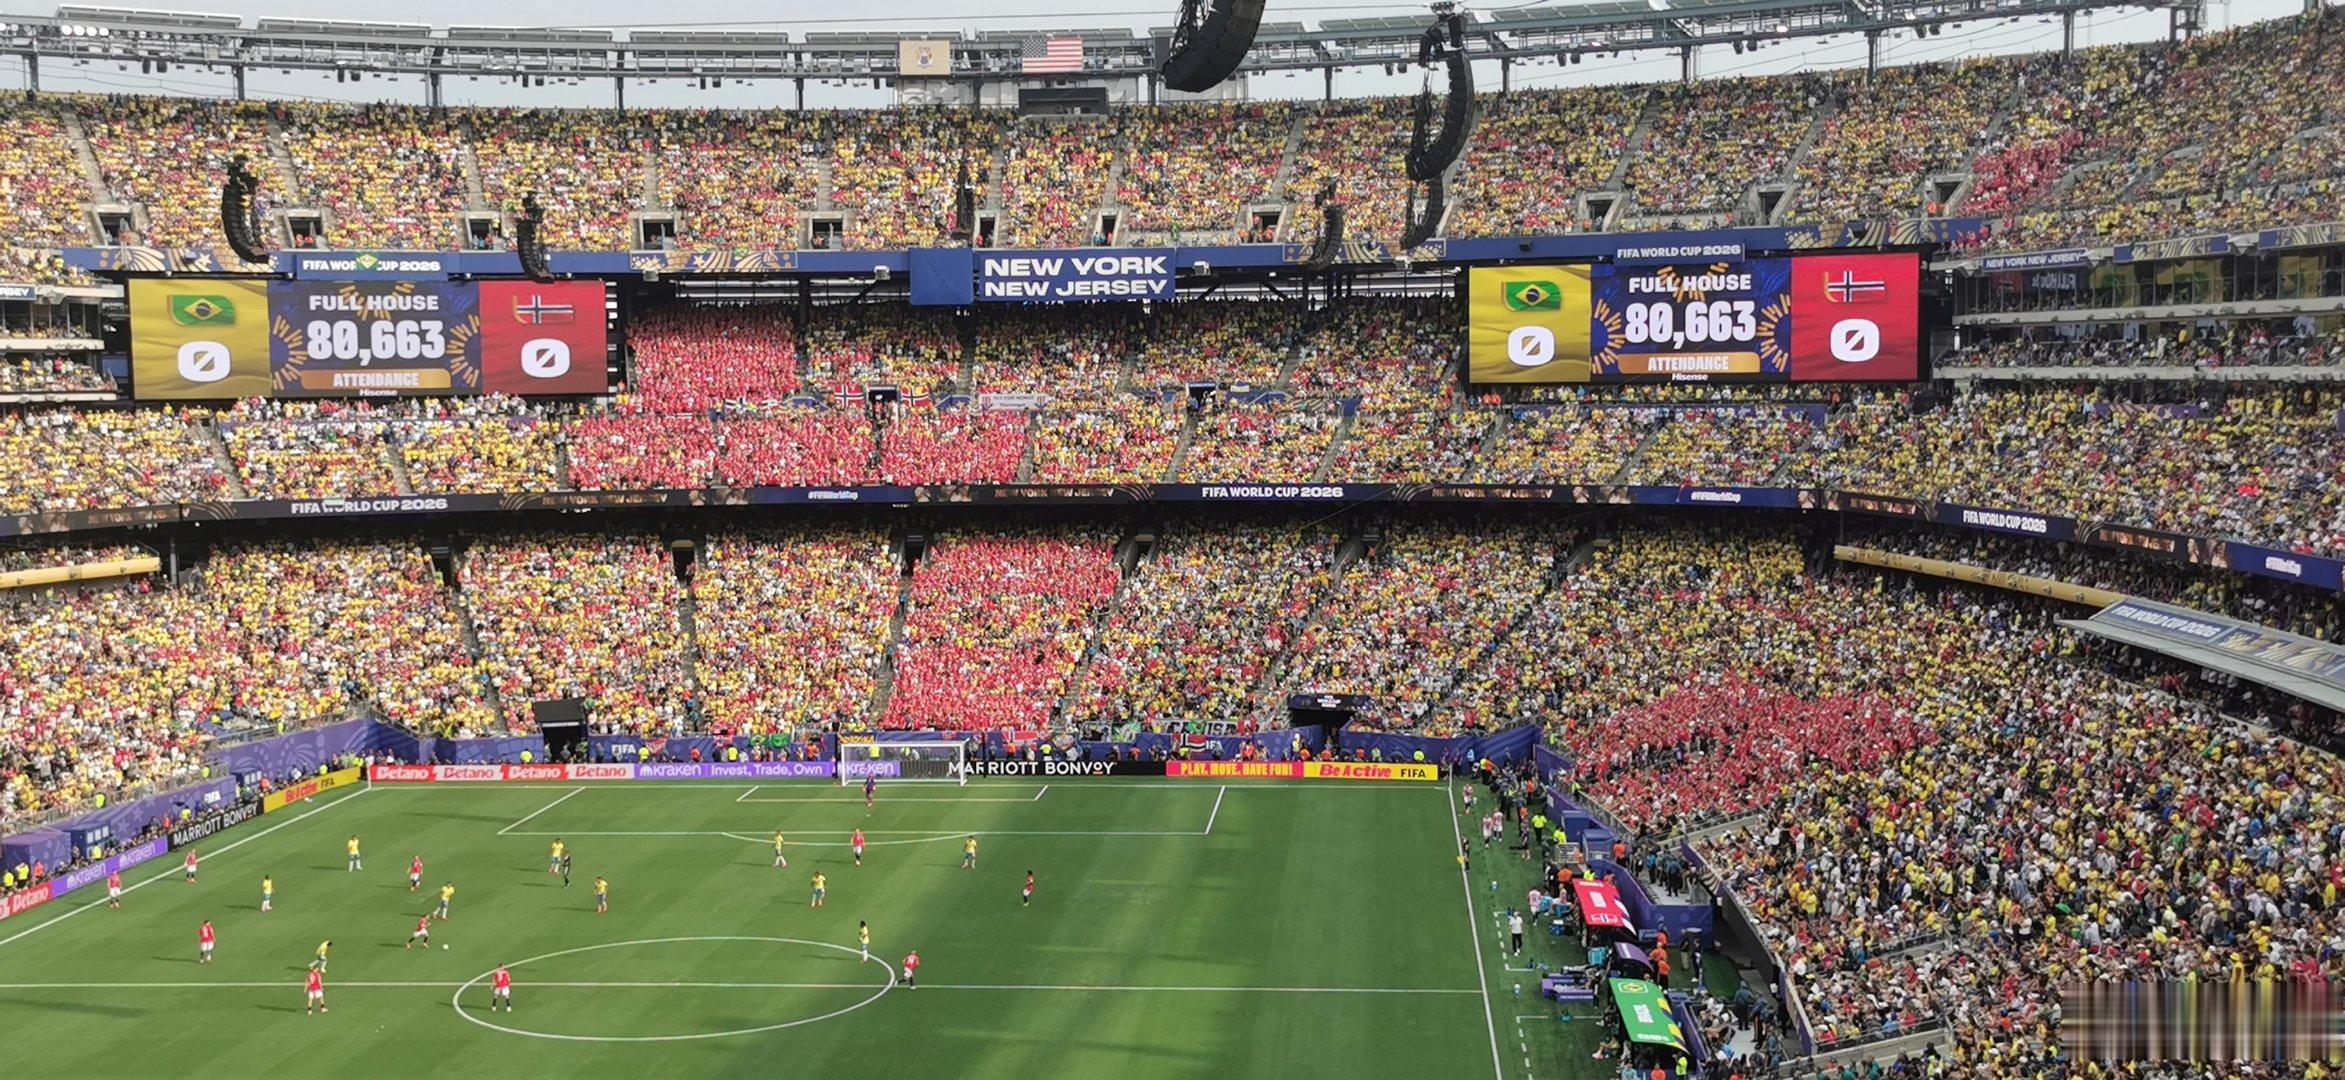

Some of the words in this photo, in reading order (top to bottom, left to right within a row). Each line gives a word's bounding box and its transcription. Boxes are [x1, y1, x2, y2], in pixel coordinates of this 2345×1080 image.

[1617, 248, 1640, 258] FIFA
[1640, 247, 1679, 257] WORLD
[1680, 246, 1701, 256] CUP
[1702, 245, 1741, 255] 2026
[303, 260, 329, 270] FIFA
[400, 261, 441, 271] 2026
[985, 258, 1063, 277] NEW
[1071, 256, 1167, 275] YORK
[1986, 259, 2004, 268] NEW
[2005, 257, 2027, 267] YORK
[2028, 255, 2047, 265] NEW
[2047, 252, 2081, 263] JERSEY
[985, 281, 1050, 297] NEW
[1055, 279, 1167, 296] JERSEY
[1629, 277, 1678, 293] FULL
[1683, 274, 1751, 291] HOUSE
[309, 295, 361, 311] FULL
[366, 294, 440, 311] HOUSE
[1625, 300, 1757, 350] 80,663
[307, 319, 446, 366] 80,663
[1647, 356, 1729, 371] ATTENDANCE
[333, 373, 419, 387] ATTENDANCE
[1671, 373, 1708, 381] Hisense
[625, 493, 668, 504] JEREY
[1074, 488, 1114, 498] JEREY
[1202, 486, 1228, 498] FIFA
[1229, 486, 1274, 498] WORLD
[1274, 486, 1300, 498] CUP
[1300, 486, 1344, 498] 2026
[291, 503, 320, 514] FIFA
[372, 500, 400, 511] CUP
[400, 498, 448, 511] 2026
[1963, 509, 1979, 524] FIFA
[1978, 512, 2005, 528] WORLD
[2005, 515, 2021, 529] CUP
[2020, 516, 2047, 533] 2026
[2111, 605, 2138, 618] FIFA
[2129, 609, 2169, 625] WORLD
[2160, 617, 2189, 629] CUP
[2177, 621, 2221, 638] 2026
[1204, 740, 1223, 750] IFA
[377, 766, 430, 780] Betano
[444, 767, 494, 778] Betano
[509, 766, 561, 778] Betano
[576, 766, 627, 777] Betano
[711, 764, 752, 777] Invest,
[753, 764, 792, 777] Trade,
[794, 764, 823, 775] Own
[949, 761, 1039, 775] MARRIOTT
[1045, 761, 1116, 776] BONVOY
[1180, 762, 1209, 776] PLAY.
[1210, 762, 1241, 776] MOVE.
[1242, 763, 1268, 776] HAVE
[1269, 763, 1293, 776] FUN!
[1401, 768, 1426, 778] FIFA
[320, 777, 335, 789] FIFA
[204, 791, 221, 802] FIFA
[173, 817, 221, 846] MARRIOTT
[223, 803, 259, 827] BONVOY
[12, 886, 49, 912] Betano
